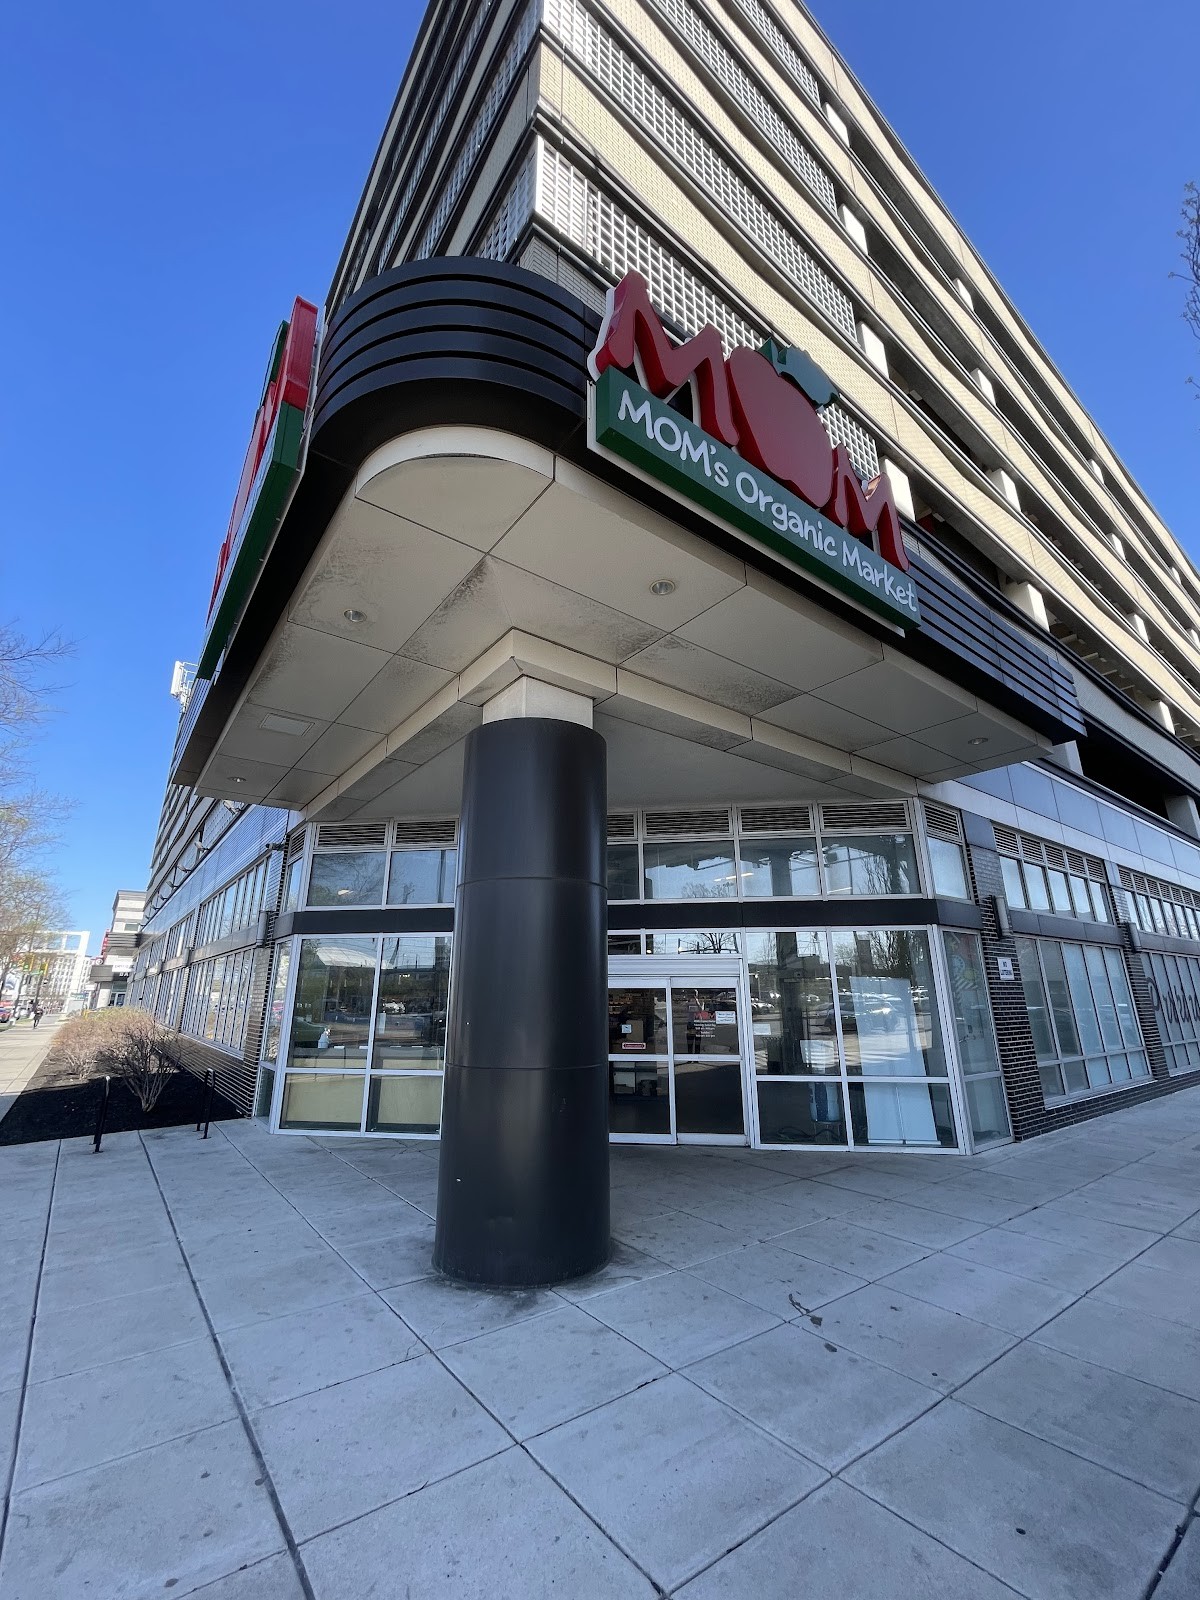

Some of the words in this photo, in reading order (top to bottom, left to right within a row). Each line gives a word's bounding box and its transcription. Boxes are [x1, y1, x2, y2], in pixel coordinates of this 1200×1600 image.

[594, 270, 910, 572] MOM
[618, 389, 730, 488] MOM's
[735, 471, 838, 557] Organic
[841, 540, 918, 612] Market
